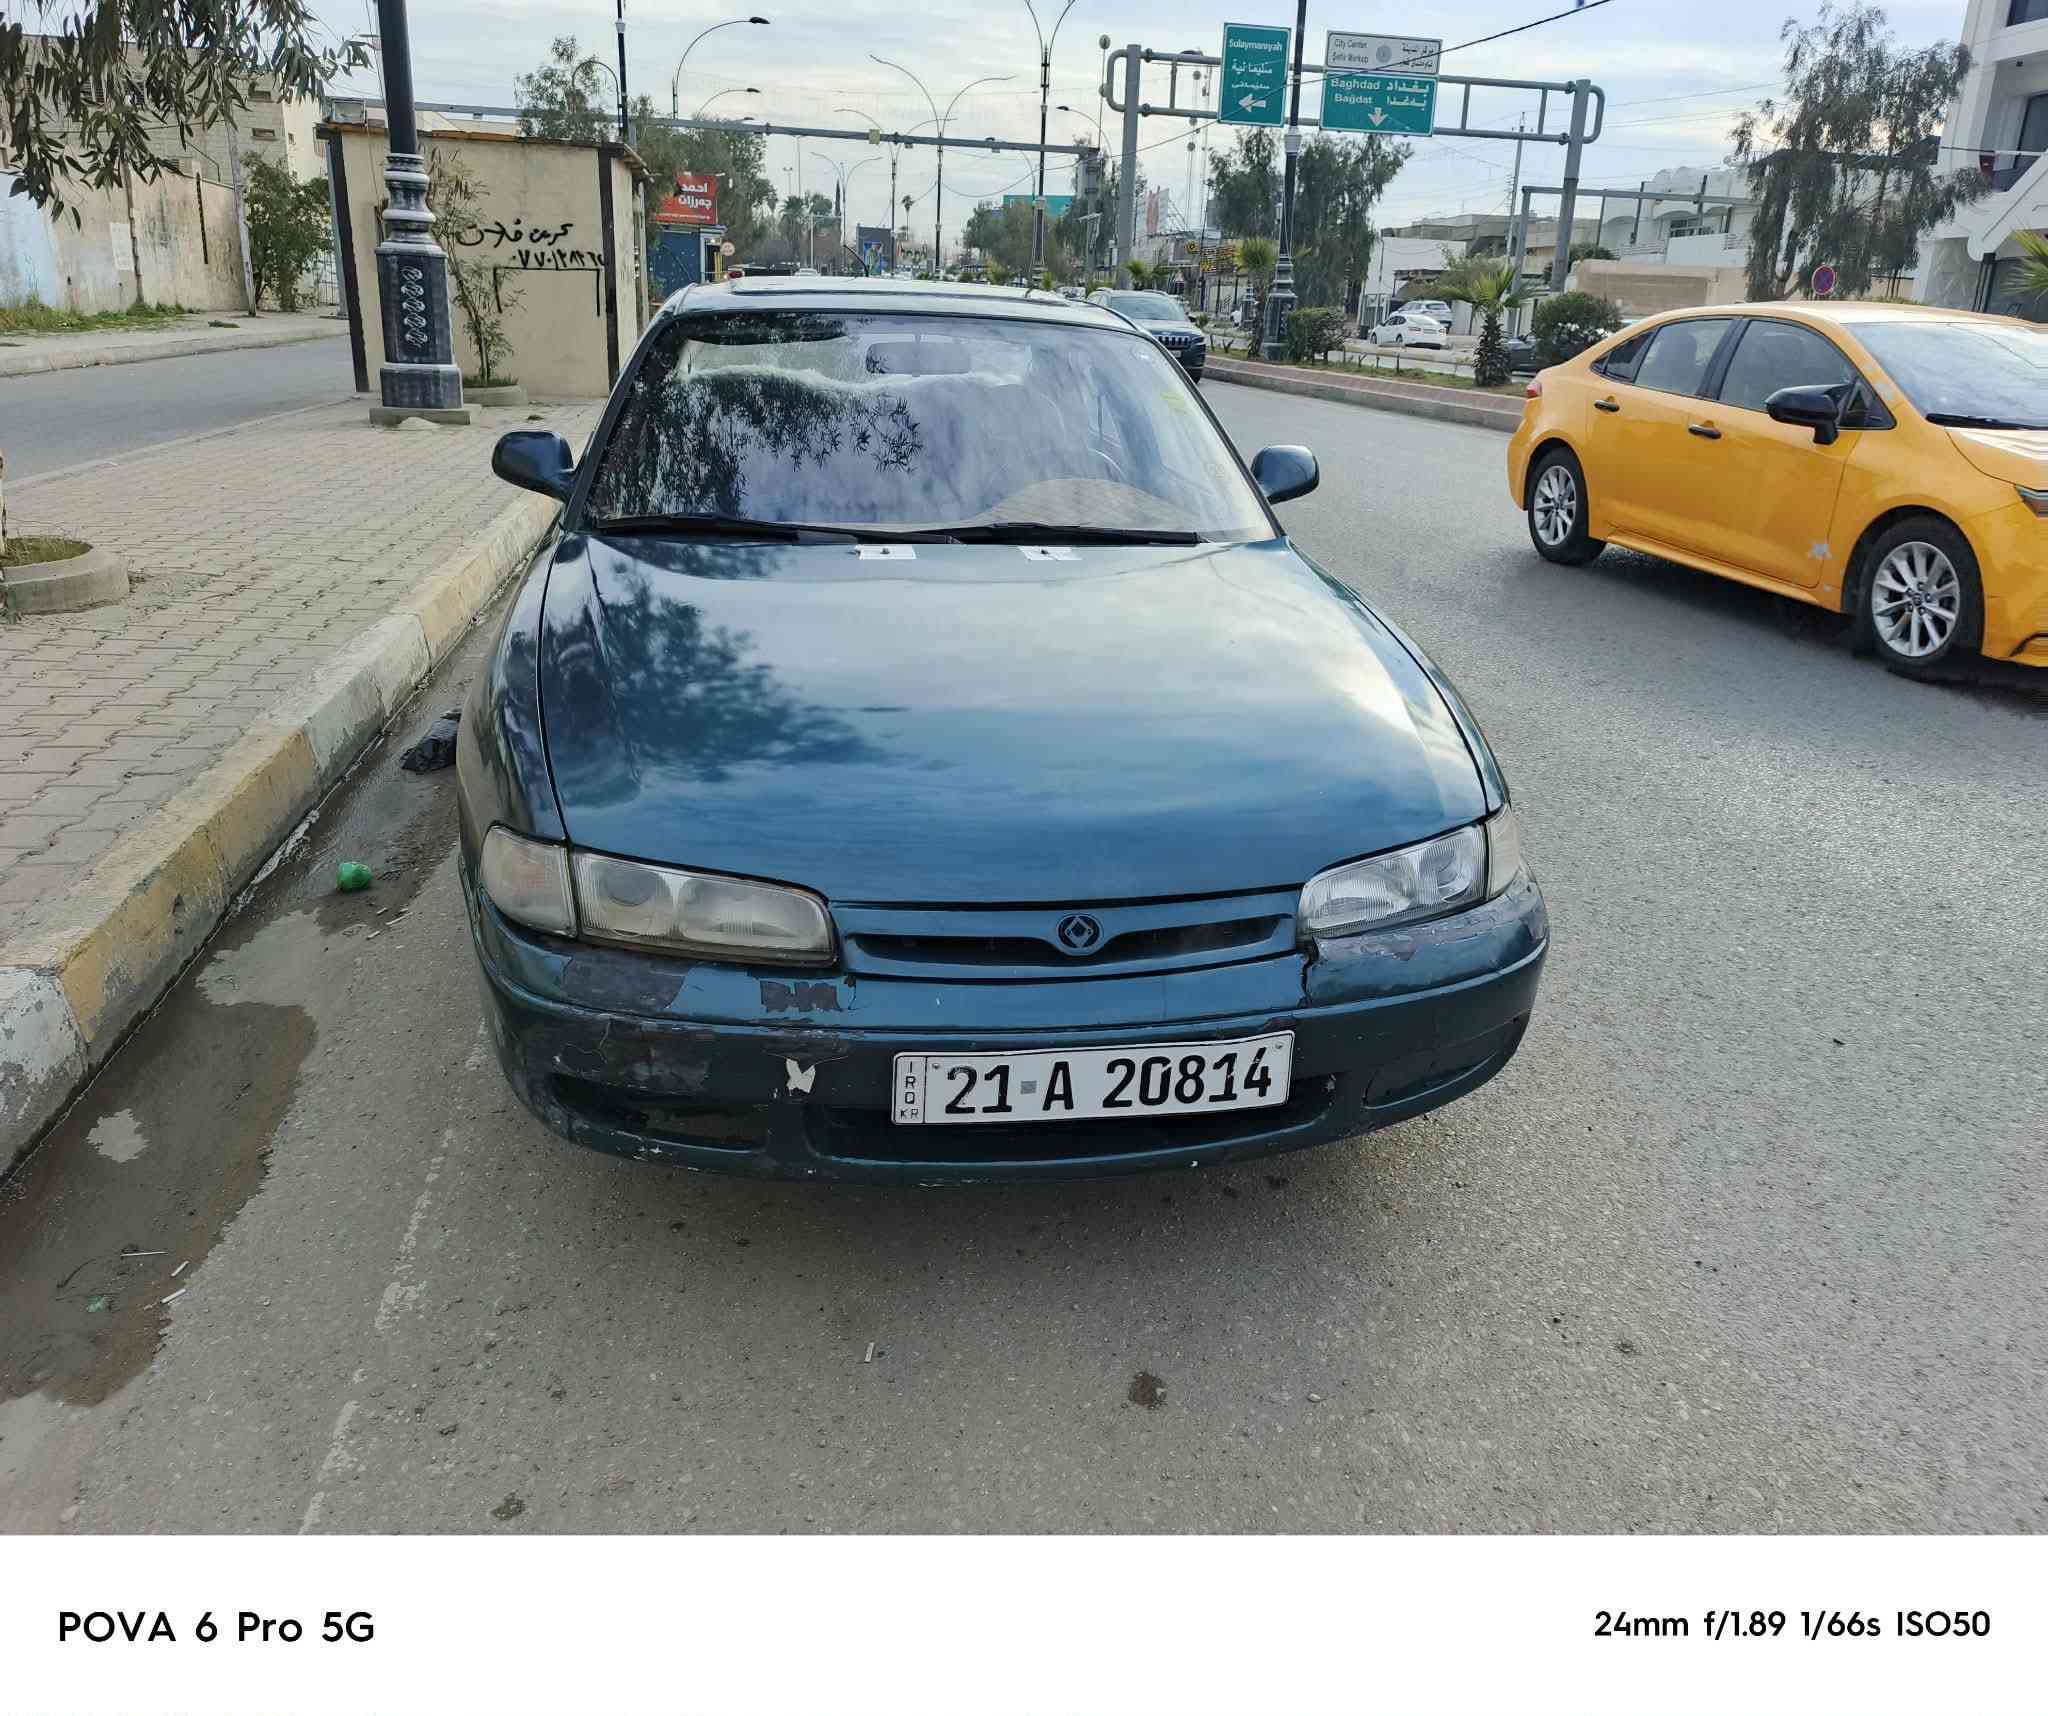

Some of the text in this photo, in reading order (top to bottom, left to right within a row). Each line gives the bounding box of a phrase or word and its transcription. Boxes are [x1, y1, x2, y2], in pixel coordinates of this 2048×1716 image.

[1331, 77, 1380, 91] Baghdad
[1385, 80, 1430, 97] بغداد
[680, 183, 708, 193] احمد
[944, 1046, 1273, 1115] 21 A 20814
[899, 1108, 920, 1121] KR
